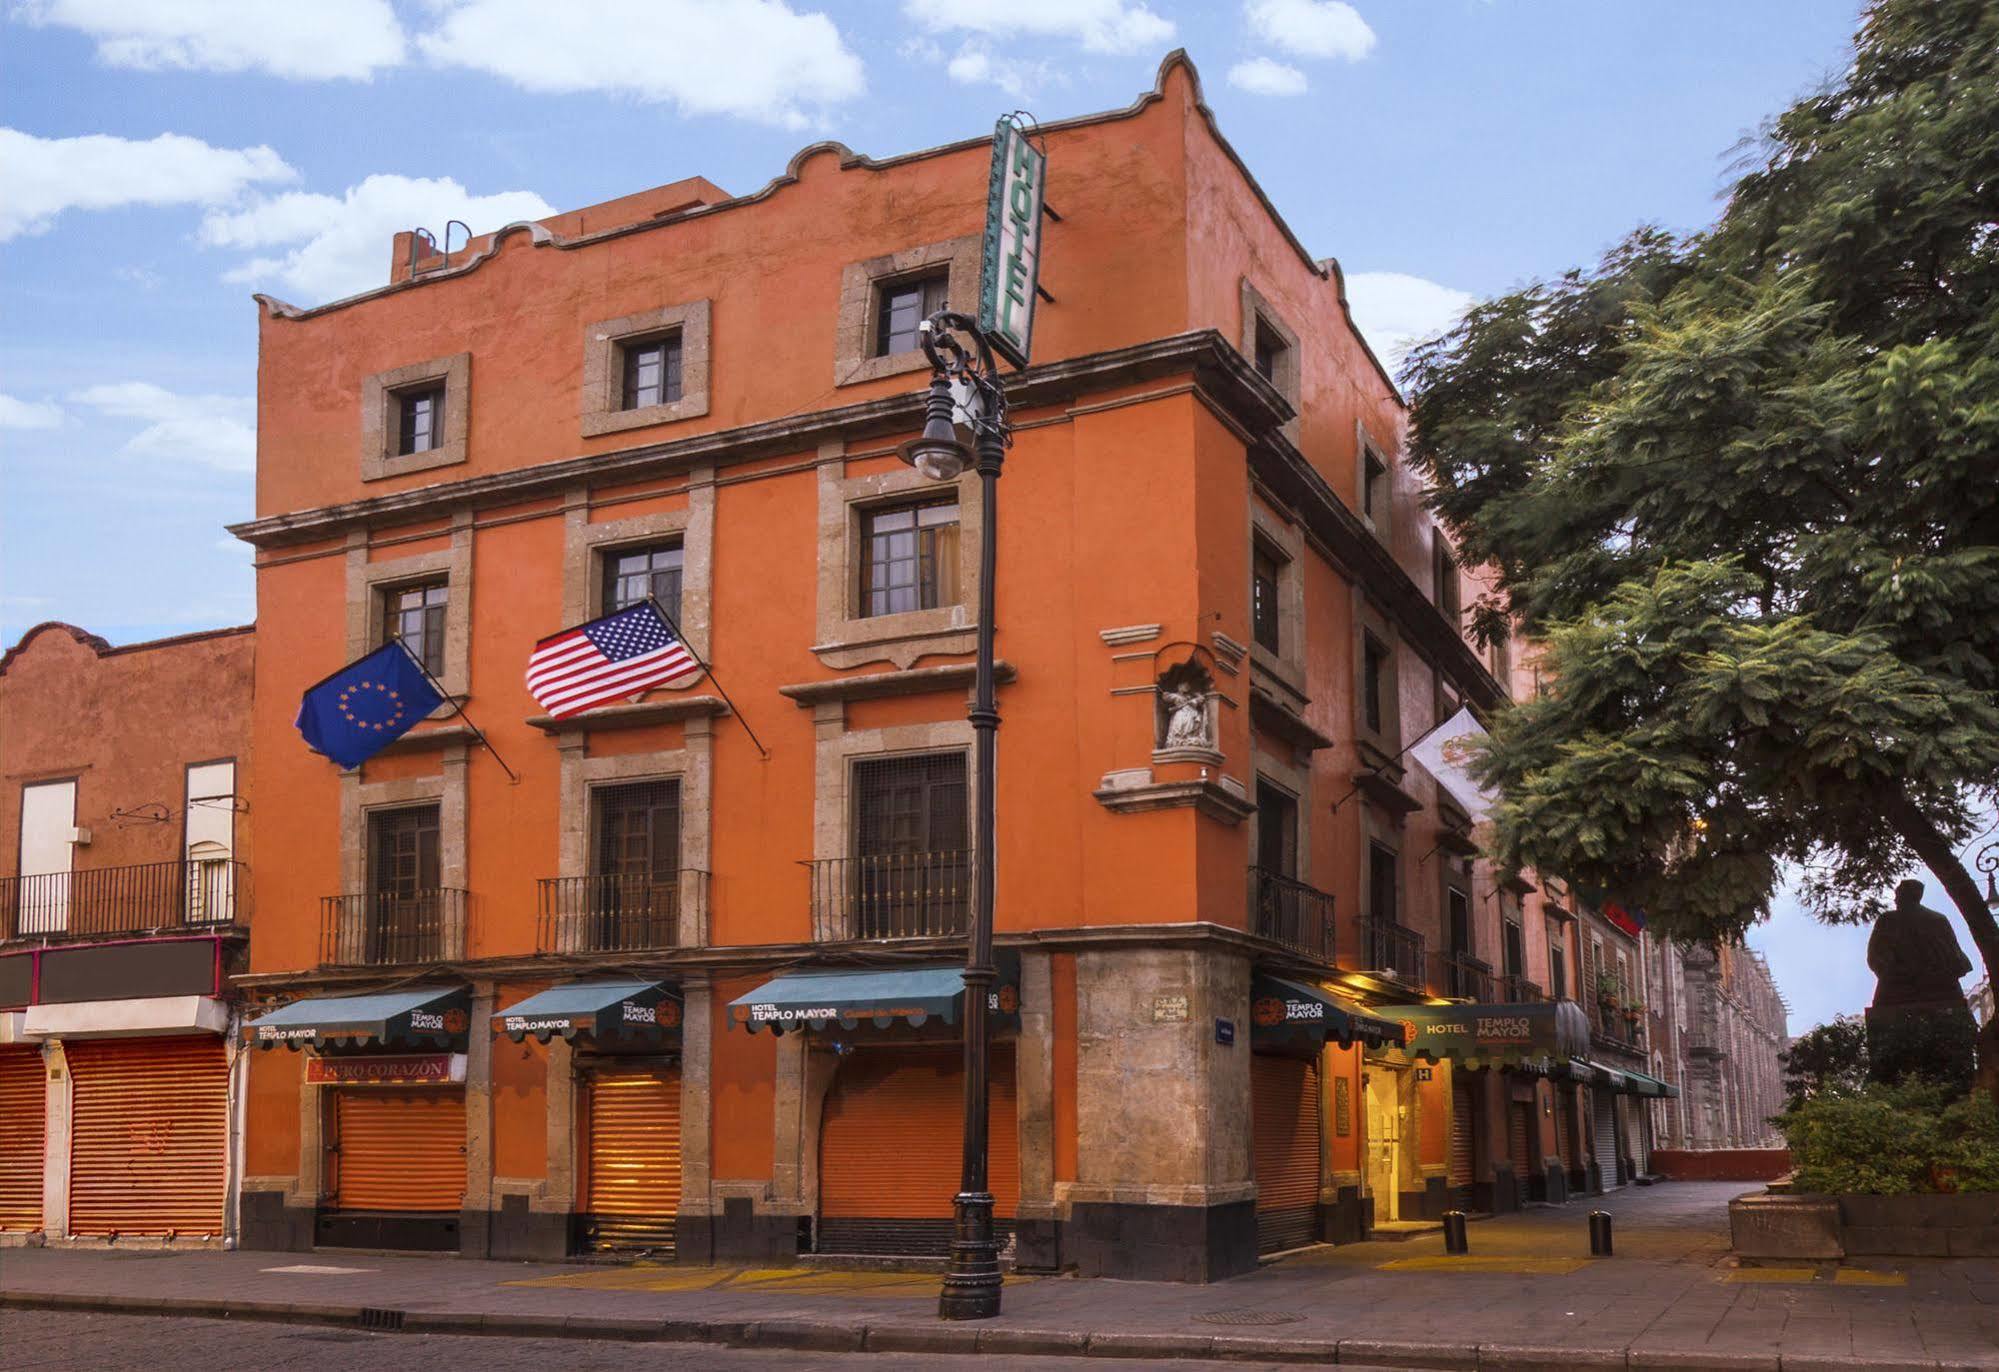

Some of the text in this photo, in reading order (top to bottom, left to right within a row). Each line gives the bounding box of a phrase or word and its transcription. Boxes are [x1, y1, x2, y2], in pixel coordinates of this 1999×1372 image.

[1002, 136, 1036, 348] HOTEL
[623, 1006, 655, 1014] TEMPLO
[1286, 1003, 1323, 1011] TEMPLO
[411, 1014, 443, 1022] TEMPLO
[623, 1014, 656, 1022] MAYOR
[752, 1010, 793, 1020] TEMPLO
[795, 1008, 837, 1019] MAYOR
[1286, 1010, 1324, 1019] MAYOR
[411, 1020, 444, 1030] MAYOR
[506, 1022, 537, 1030] TEMPLO
[538, 1020, 570, 1029] MAYOR
[1476, 1018, 1529, 1028] TEMPLO
[288, 1029, 316, 1039] MAYOR
[1426, 1024, 1468, 1034] HOTEL
[1476, 1026, 1530, 1037] MAYOR
[368, 1060, 443, 1076] CORAZÓN
[1418, 1070, 1430, 1080] H
